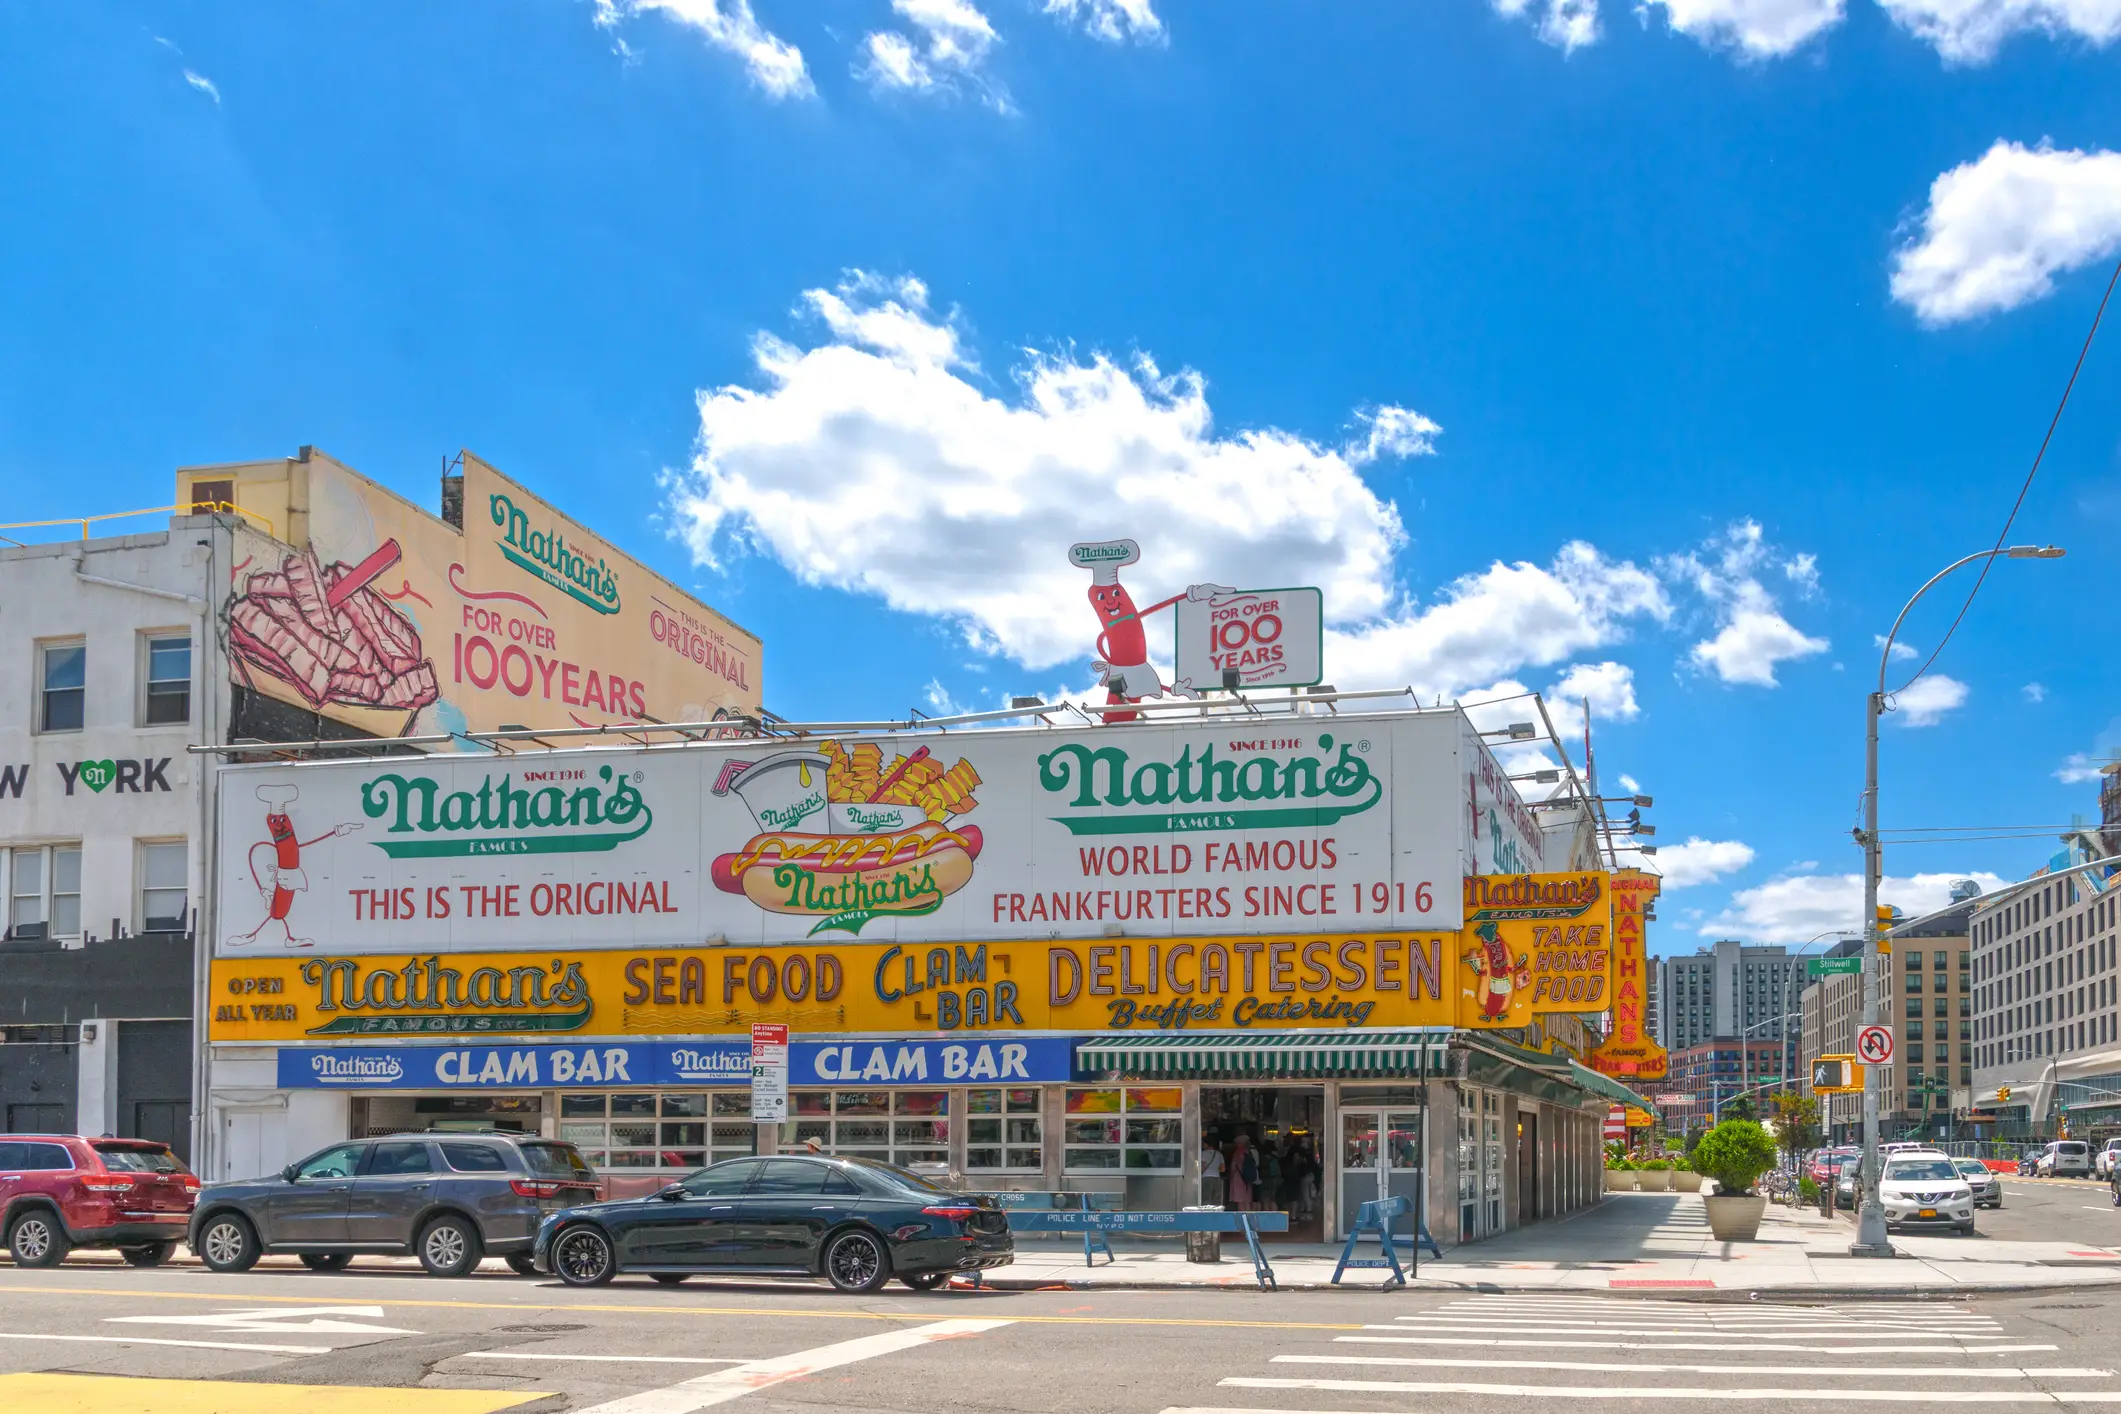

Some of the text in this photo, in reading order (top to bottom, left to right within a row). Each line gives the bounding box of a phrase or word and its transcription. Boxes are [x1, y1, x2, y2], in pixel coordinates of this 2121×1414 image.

[489, 493, 620, 604] Nathan's
[1075, 544, 1131, 558] Nathan's
[1211, 600, 1280, 623] FOR OVER
[463, 604, 557, 651] FOR OVER
[680, 610, 724, 646] THIS IS THE
[1210, 613, 1283, 653] 100
[650, 609, 749, 692] ORIGINAL
[1209, 645, 1284, 672] YEARS
[1262, 670, 1275, 680] 1916
[1229, 738, 1303, 752] SINCE 1916
[524, 769, 587, 782] SINCE 1916
[1037, 733, 1383, 808] Nathan's
[1477, 744, 1495, 794] THIS
[361, 765, 652, 833] Nathan's
[760, 791, 824, 827] Nathan's
[847, 807, 903, 825] Nathan's
[1166, 815, 1235, 830] FAMOUS
[469, 841, 529, 853] FAMOUS
[1079, 838, 1338, 877] WORLD FAMOUS
[773, 862, 938, 910] Nathan's
[1464, 874, 1601, 907] Nathan's
[1611, 879, 1658, 890] RIGINAL
[349, 880, 679, 921] THIS IS THE ORIGINAL
[993, 881, 1434, 923] FRANKFURTERS SINCE 1916
[831, 911, 869, 925] FAMOUS
[1532, 925, 1605, 948] TAKE
[873, 944, 987, 1004] CLAM
[1047, 939, 1442, 1007] DELICATESSEN
[1534, 950, 1608, 973] HOME
[1820, 960, 1850, 968] Stillwell
[228, 977, 284, 995] OPEN
[300, 955, 591, 1011] Nathan's
[623, 953, 844, 1006] SEA FOOD
[1532, 976, 1605, 1003] FOOD
[215, 1004, 297, 1022] ALL YEAR
[937, 980, 1026, 1030] BAR
[1107, 995, 1376, 1029] Buffet Catering
[363, 1017, 493, 1032] FAMOUS
[311, 1054, 402, 1076] Nathan's
[671, 1049, 752, 1071] Nathan
[814, 1044, 1031, 1081] CLAM BAR
[1611, 1048, 1647, 1057] FAMOUS
[435, 1048, 632, 1085] CLAM BAR
[755, 1067, 762, 1076] 2
[1001, 1193, 1025, 1201] CROSS
[1047, 1214, 1076, 1222] POLICE
[1082, 1214, 1100, 1222] LINE
[1113, 1214, 1125, 1222] DO
[1128, 1214, 1144, 1222] NOT
[1148, 1214, 1175, 1222] CROSS
